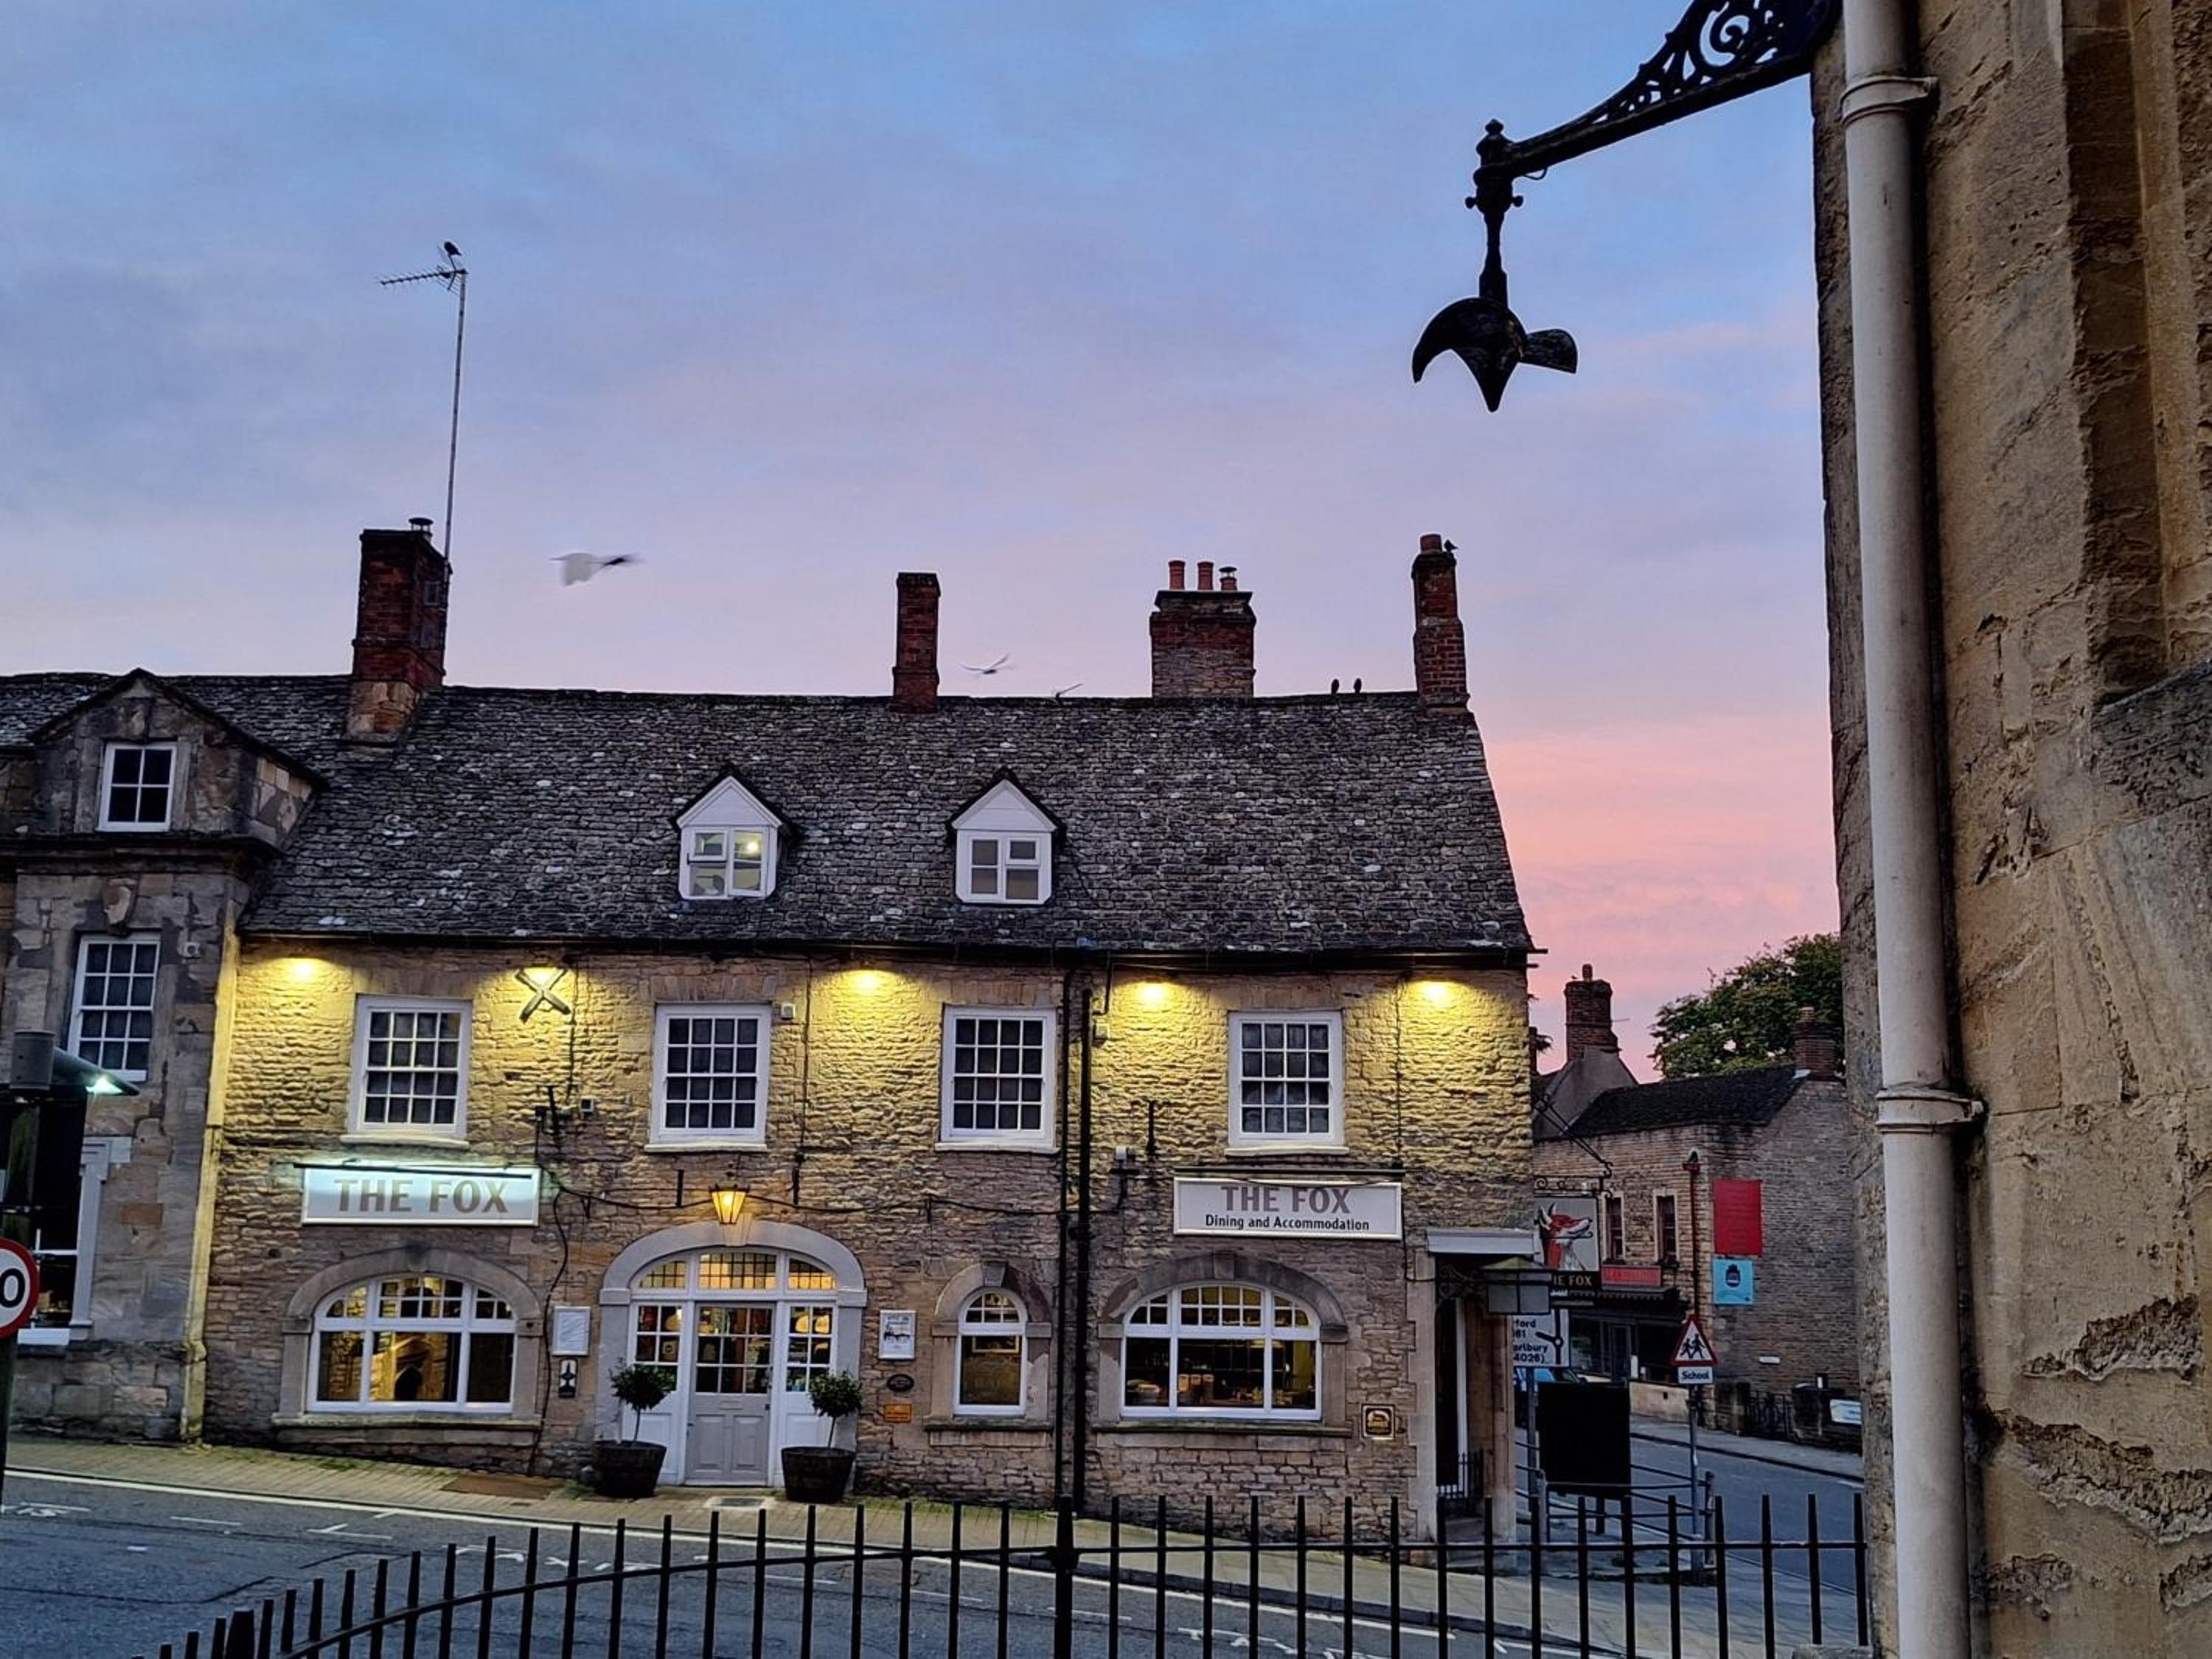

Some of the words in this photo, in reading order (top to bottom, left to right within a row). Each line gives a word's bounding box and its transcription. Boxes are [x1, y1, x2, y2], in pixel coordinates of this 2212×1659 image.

[334, 1179, 414, 1211] THE
[429, 1180, 508, 1213] FOX
[1221, 1186, 1279, 1211] THE
[1291, 1186, 1351, 1214] FOX
[1205, 1214, 1244, 1230] Dining
[1248, 1216, 1270, 1228] and
[1273, 1217, 1370, 1231] Accommodation
[1568, 1274, 1593, 1287] FOX
[1681, 1371, 1710, 1380] School
